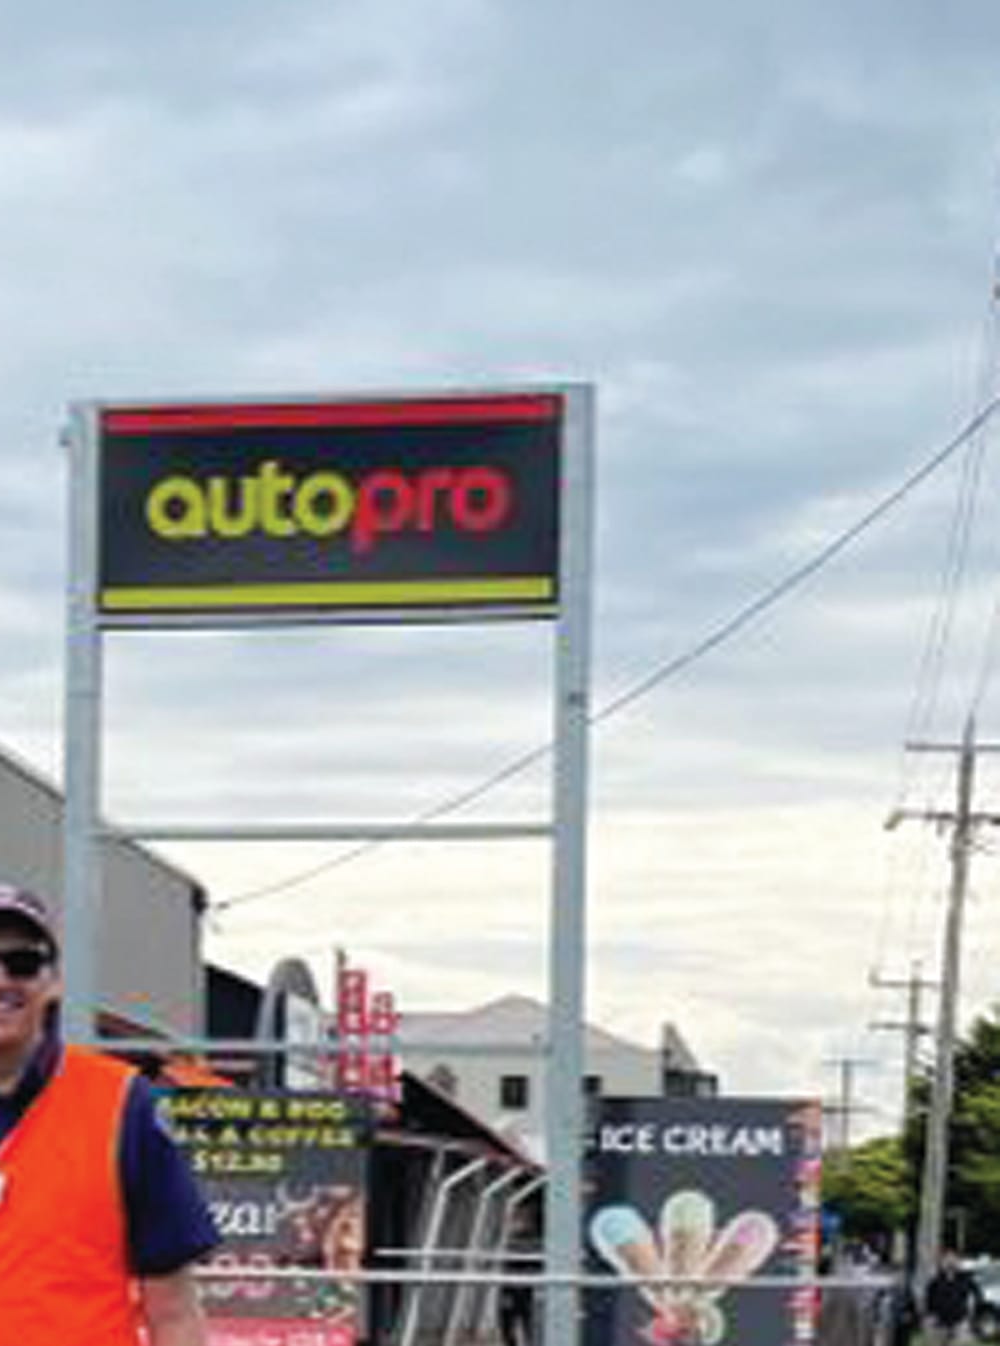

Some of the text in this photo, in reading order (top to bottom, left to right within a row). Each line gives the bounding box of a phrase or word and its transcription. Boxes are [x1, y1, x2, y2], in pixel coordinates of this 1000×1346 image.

[146, 461, 512, 554] autopro
[601, 1123, 783, 1156] ICE CREAM
